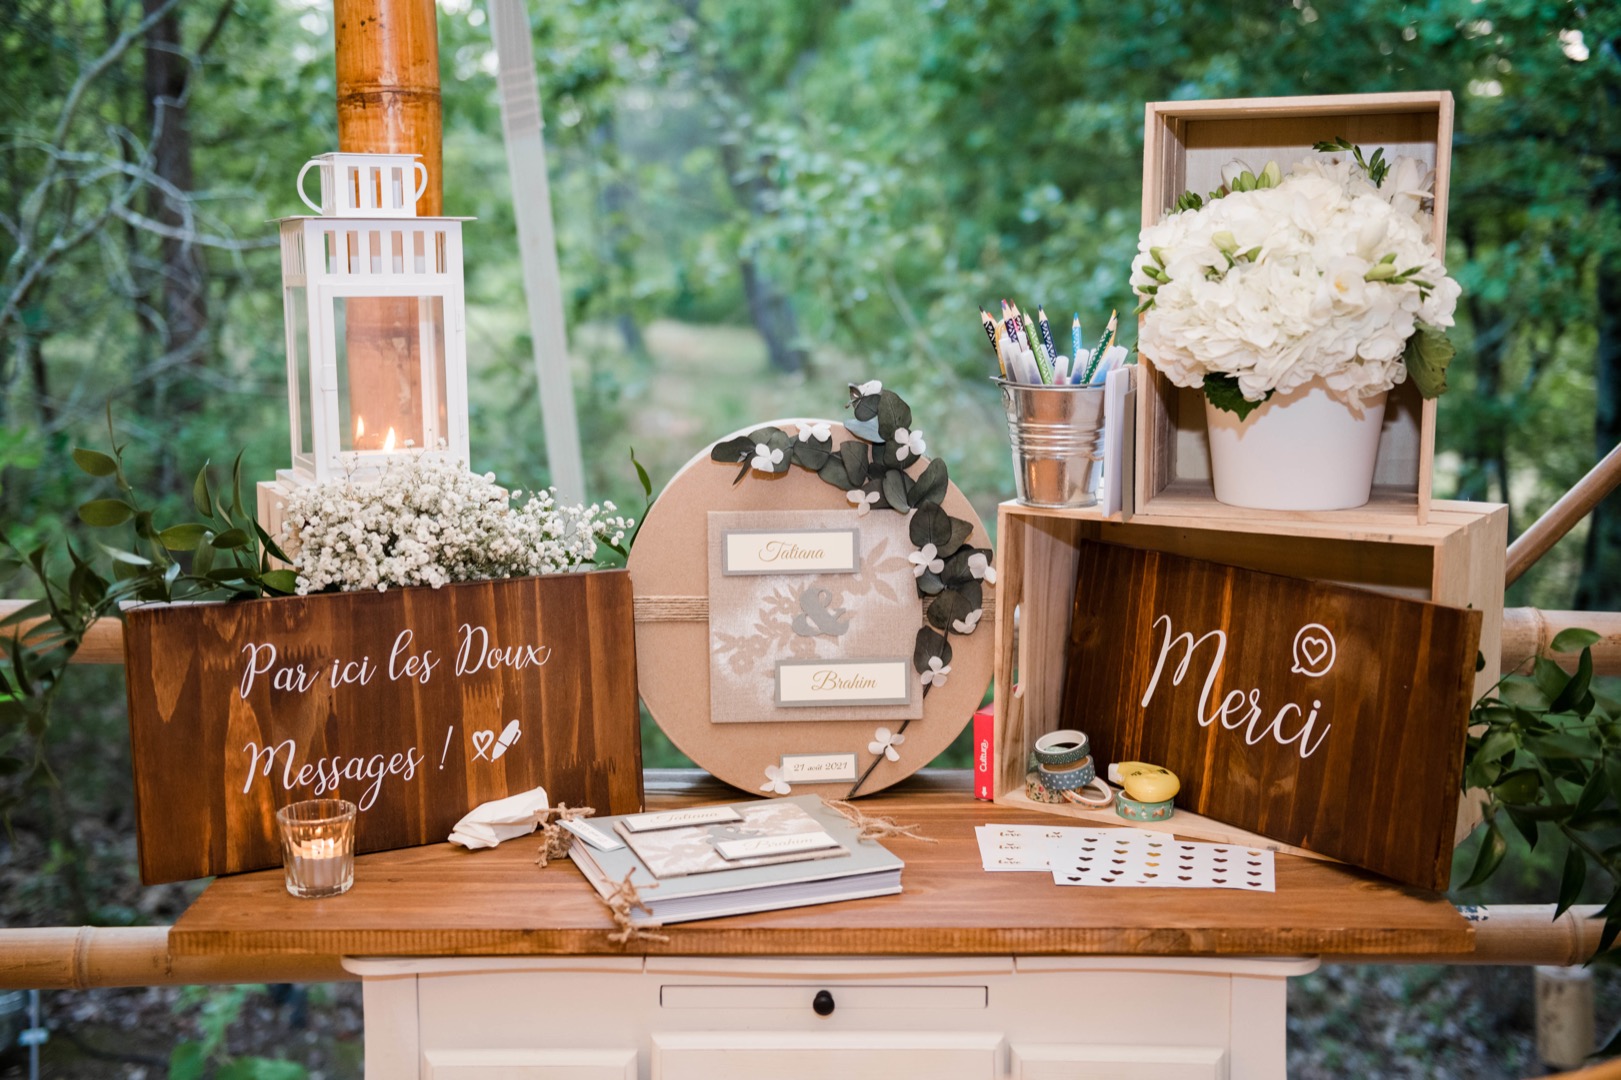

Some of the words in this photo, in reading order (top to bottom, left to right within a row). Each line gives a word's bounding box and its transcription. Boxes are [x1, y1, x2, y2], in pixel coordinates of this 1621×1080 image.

[758, 540, 825, 562] Tatiana
[240, 642, 320, 699] Par
[330, 655, 377, 688] ici
[388, 629, 440, 684] les
[455, 623, 552, 677] Doux
[811, 669, 877, 691] Brahim
[1141, 614, 1331, 759] Merci
[793, 763, 805, 772] 21
[825, 761, 848, 770] 2021
[979, 739, 989, 773] Cultura
[243, 739, 424, 812] Messages
